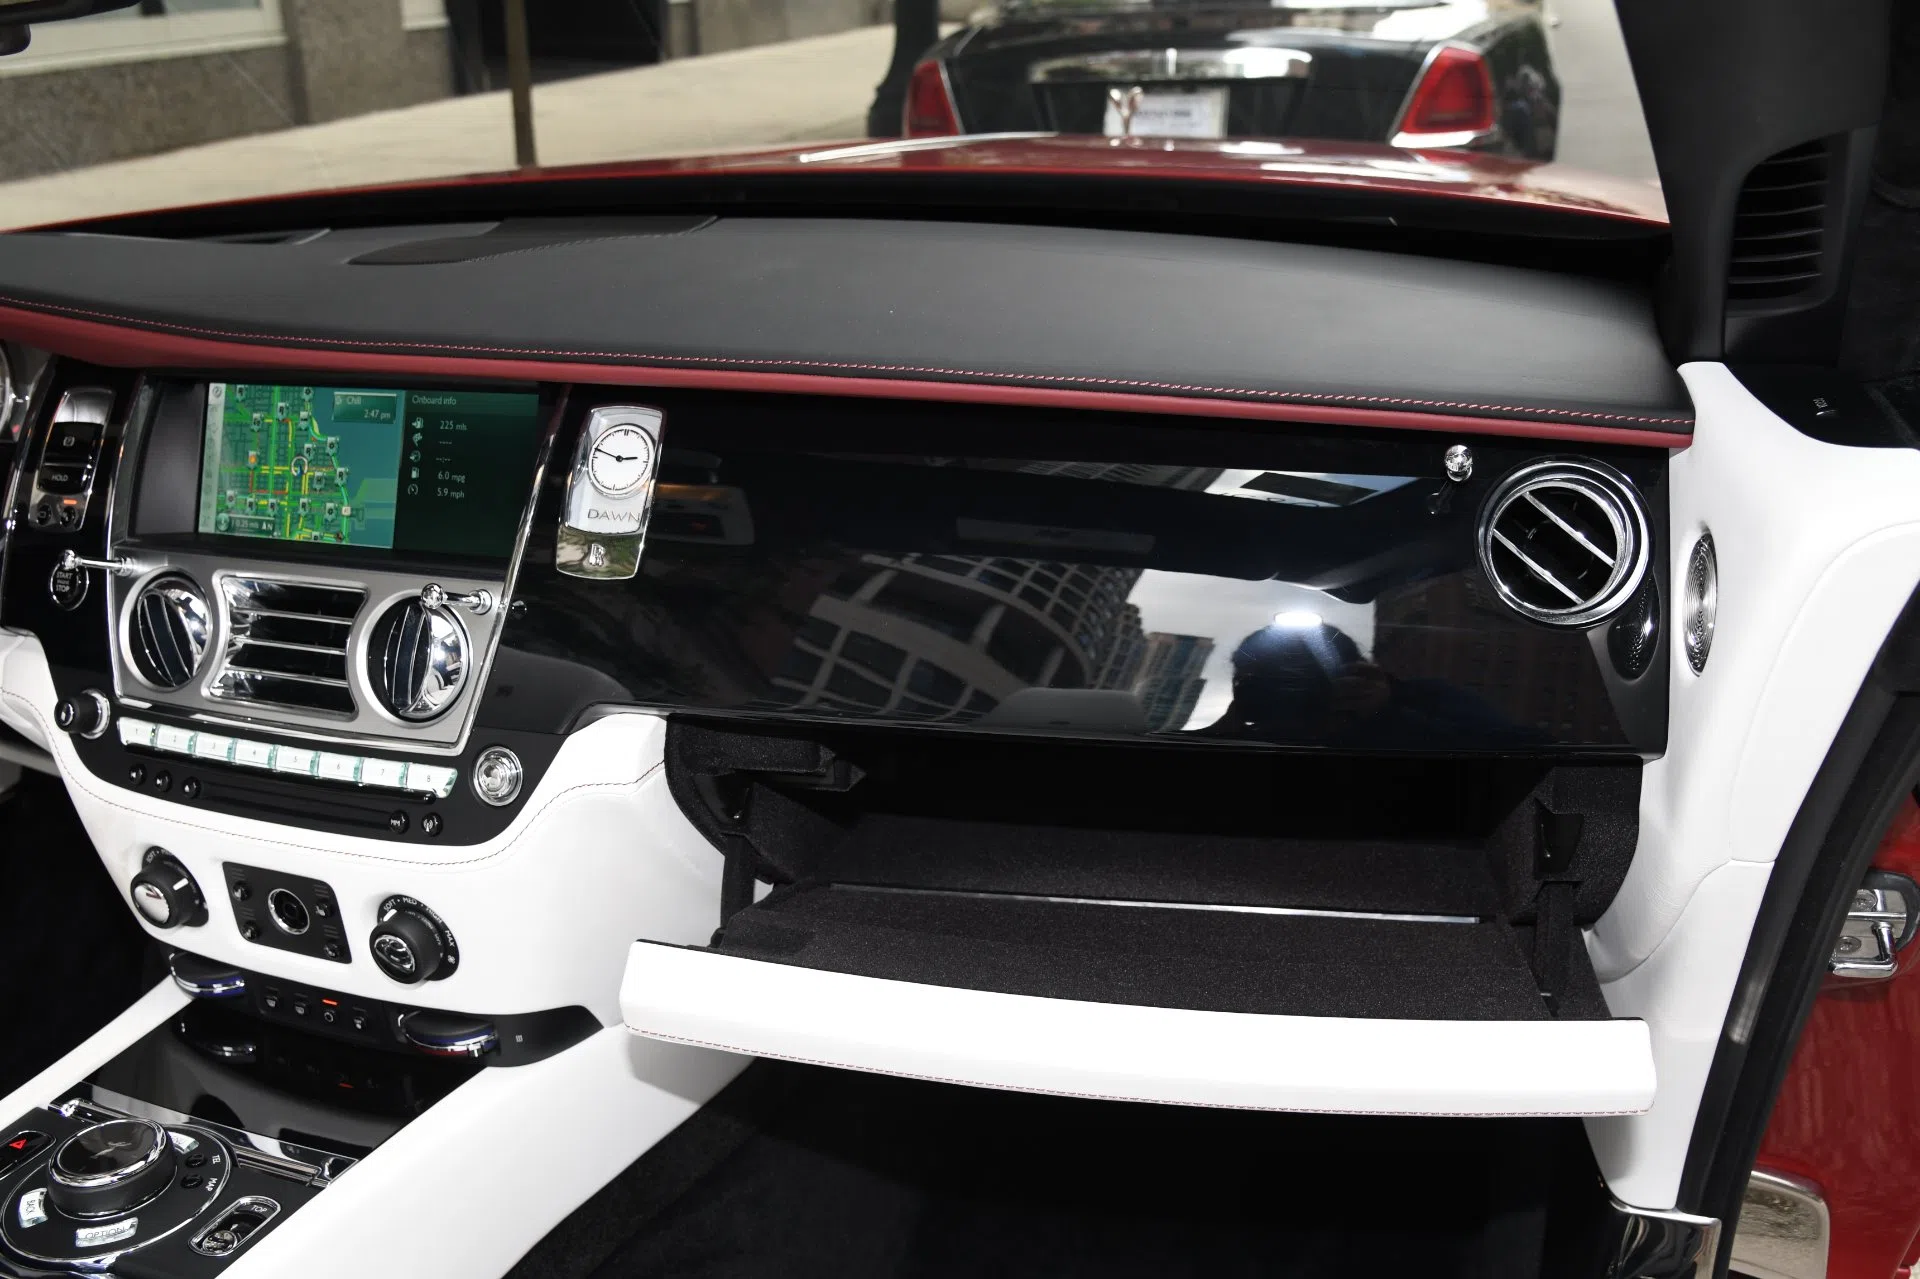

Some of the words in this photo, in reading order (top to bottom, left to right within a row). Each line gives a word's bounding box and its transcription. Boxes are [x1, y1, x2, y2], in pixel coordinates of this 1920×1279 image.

[412, 395, 443, 405] Onboard
[443, 395, 457, 406] info
[363, 409, 380, 419] 2:47
[380, 412, 392, 421] pm
[440, 420, 454, 430] 225
[51, 474, 69, 482] HOLD
[438, 470, 450, 480] 6.0
[451, 474, 466, 484] mpg
[437, 487, 449, 497] 5.9
[450, 490, 465, 500] mph
[586, 508, 641, 523] DAWN
[56, 571, 73, 580] START
[55, 584, 70, 593] STOP
[383, 898, 397, 912] SOFT
[402, 896, 418, 906] MED
[444, 929, 456, 947] MAX
[211, 1154, 221, 1165] TEL
[205, 1177, 219, 1192] MAP
[251, 1204, 268, 1213] TOP
[85, 1226, 128, 1240] OPTION
